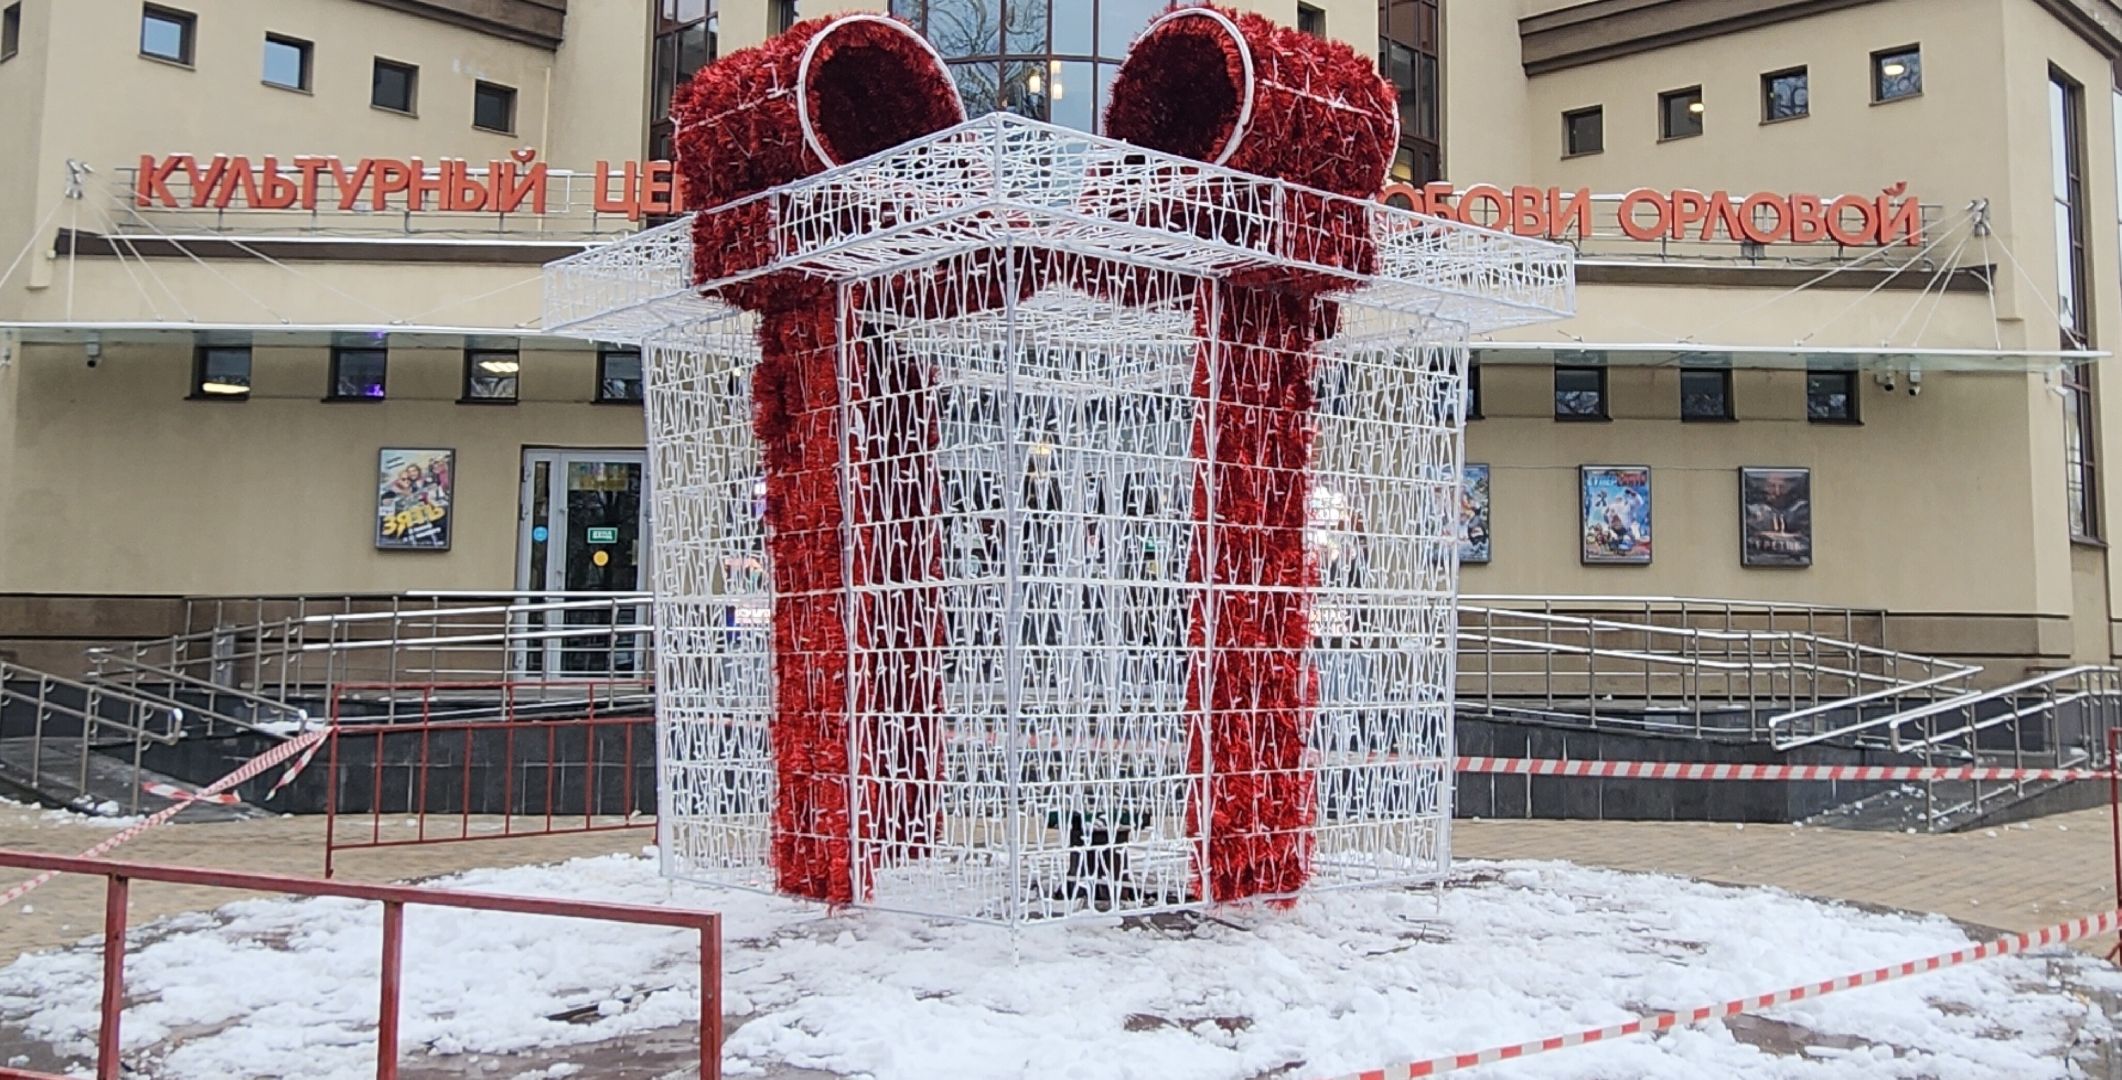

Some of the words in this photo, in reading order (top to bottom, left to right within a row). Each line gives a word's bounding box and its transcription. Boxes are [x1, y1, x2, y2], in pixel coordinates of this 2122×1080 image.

[137, 148, 547, 214] КУЛЬТУРНЫЙ
[1618, 181, 1920, 246] ОРЛОВОЙ
[382, 503, 446, 538] ЗЯТЬ
